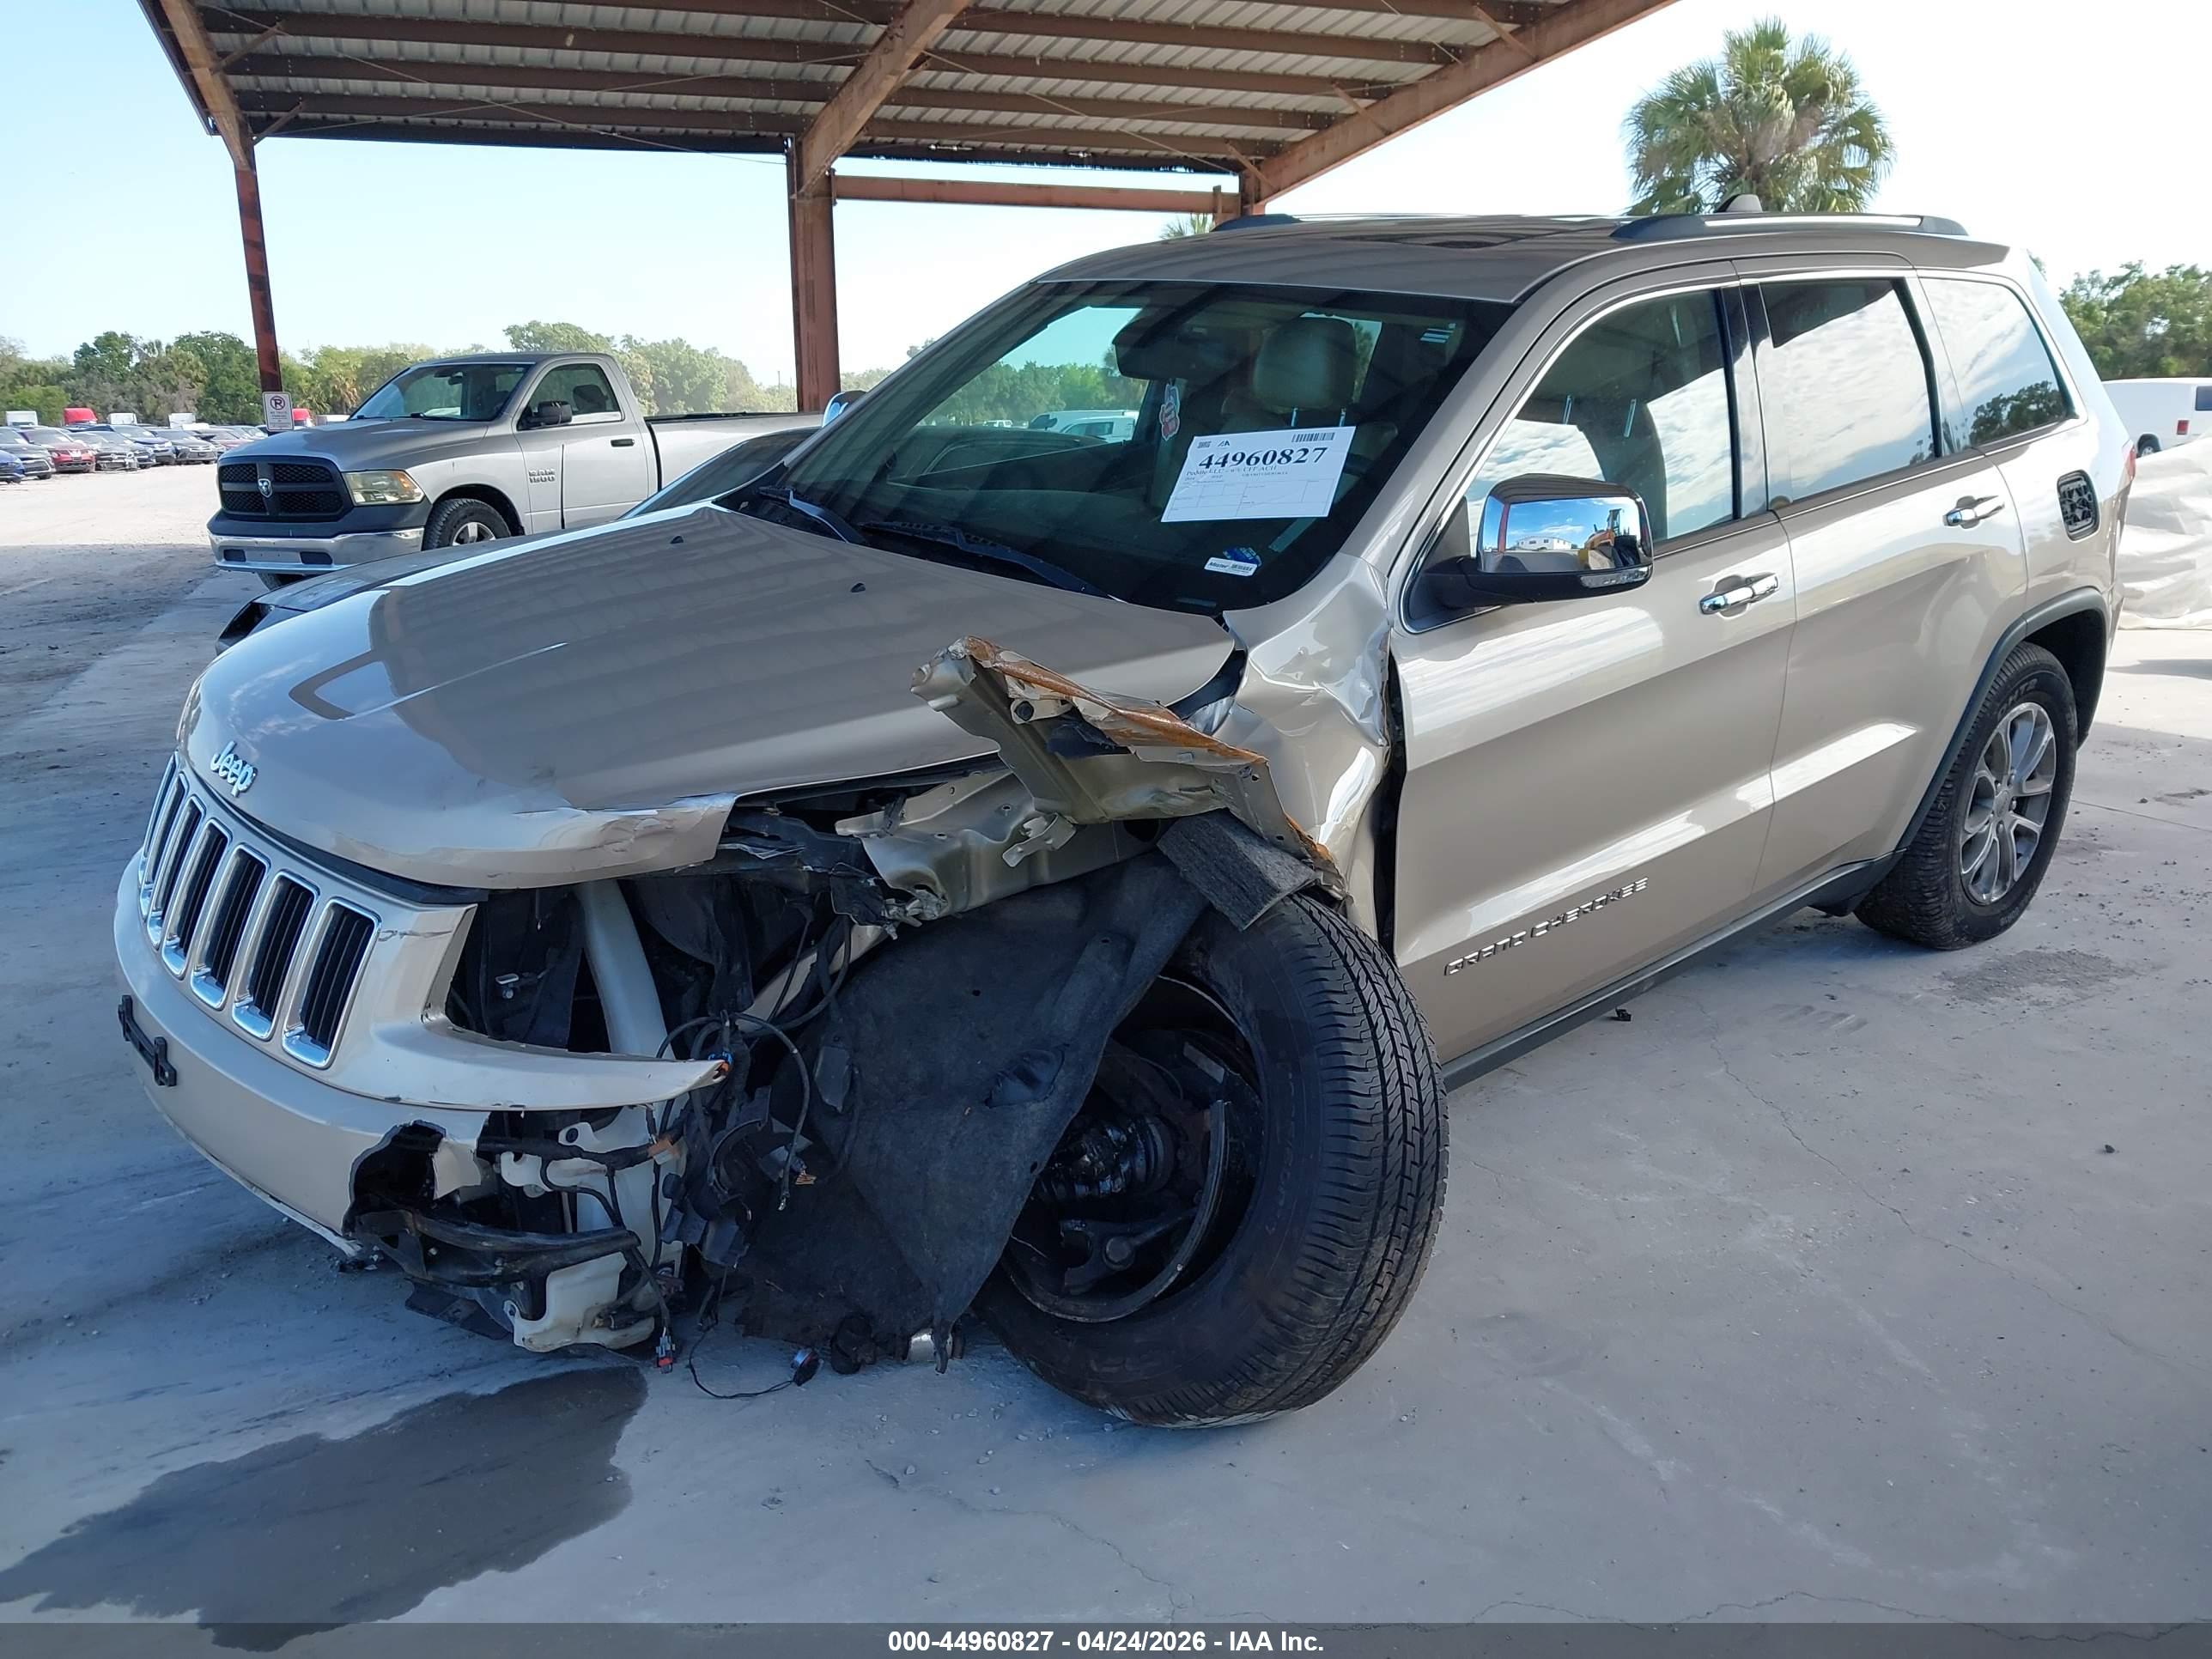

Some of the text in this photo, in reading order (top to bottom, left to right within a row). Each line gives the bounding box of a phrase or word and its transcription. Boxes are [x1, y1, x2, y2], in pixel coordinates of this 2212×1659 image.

[529, 474, 556, 483] 1500
[1199, 447, 1328, 470] 44960827
[210, 740, 258, 797] Jeep
[1444, 877, 1649, 975] GRAND CHEROKEE
